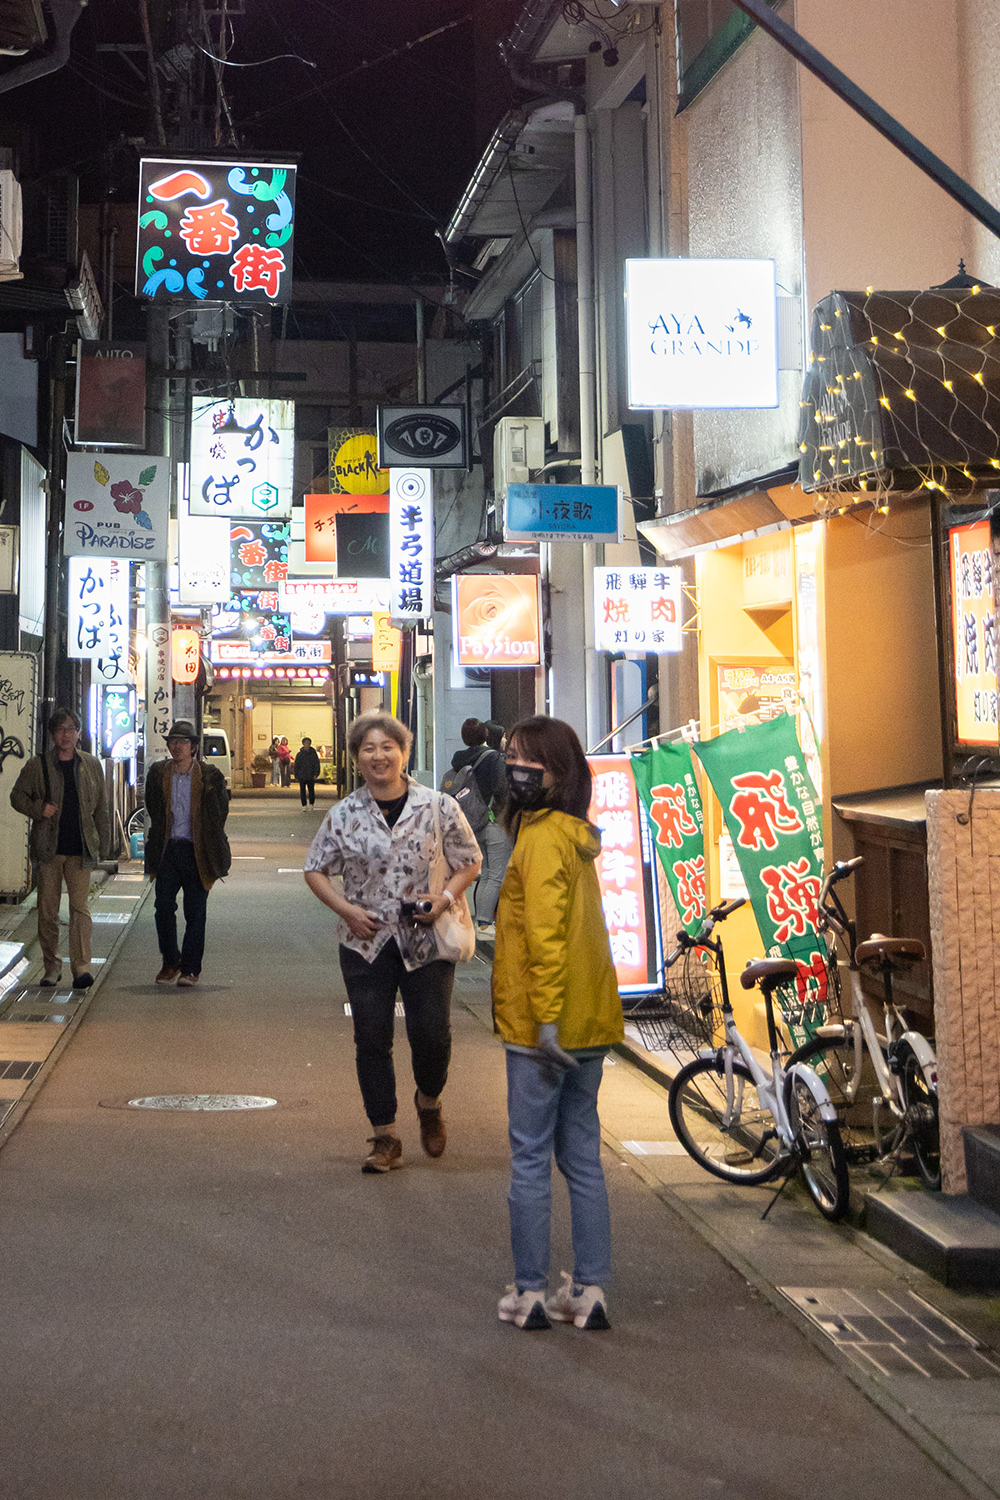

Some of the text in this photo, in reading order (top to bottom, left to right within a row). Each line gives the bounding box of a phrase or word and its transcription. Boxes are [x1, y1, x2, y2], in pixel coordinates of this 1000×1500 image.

[148, 169, 286, 298] 一番街
[649, 313, 706, 335] AYA
[202, 414, 280, 506] かっぱ
[335, 461, 366, 477] BLACK
[97, 521, 121, 529] PUB
[532, 501, 593, 520] 小夜歌
[398, 504, 424, 612] 半弓道場
[605, 572, 671, 591] 飛騨牛
[78, 566, 105, 650] かっぱ
[602, 595, 677, 624] 焼肉
[459, 631, 537, 660] Passion
